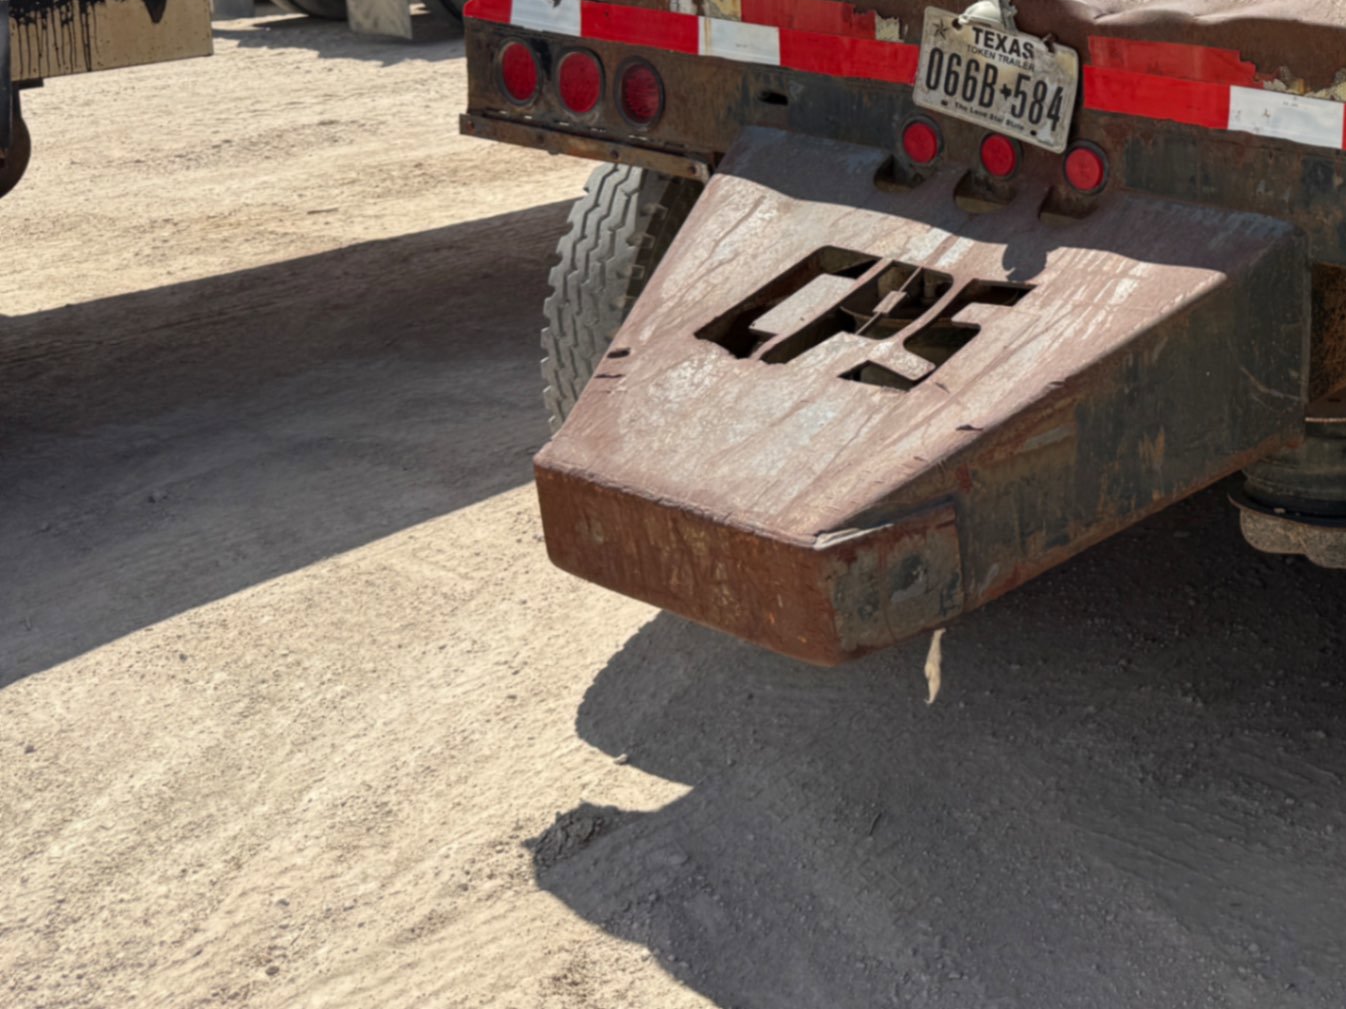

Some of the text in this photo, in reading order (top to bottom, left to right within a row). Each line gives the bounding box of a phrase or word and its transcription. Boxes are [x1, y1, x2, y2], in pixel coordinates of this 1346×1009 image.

[972, 26, 1034, 59] TEXAS
[967, 44, 1035, 72] TOKEN TRAILER
[954, 102, 967, 112] The
